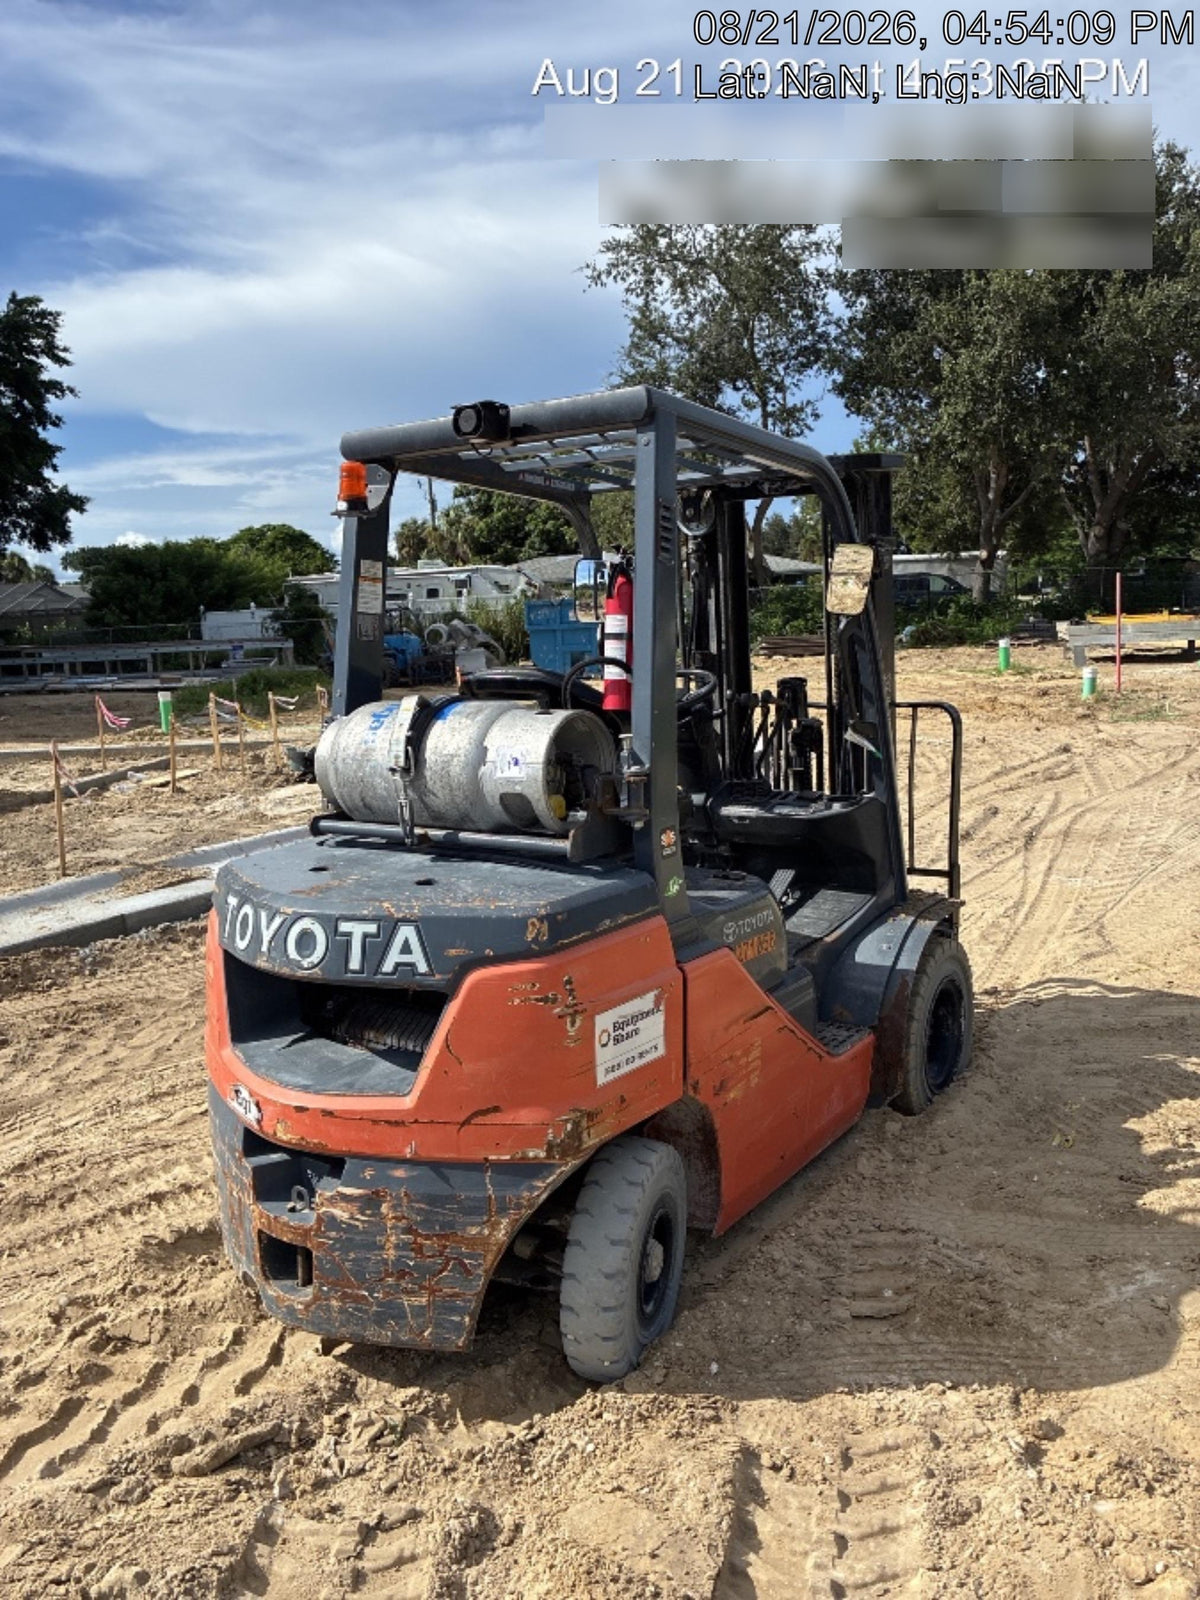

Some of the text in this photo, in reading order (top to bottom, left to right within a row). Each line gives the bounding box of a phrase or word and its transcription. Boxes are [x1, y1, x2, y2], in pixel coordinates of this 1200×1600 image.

[223, 894, 436, 978] TOYOTA
[736, 909, 774, 936] TOYOTA
[612, 1027, 640, 1046] Share
